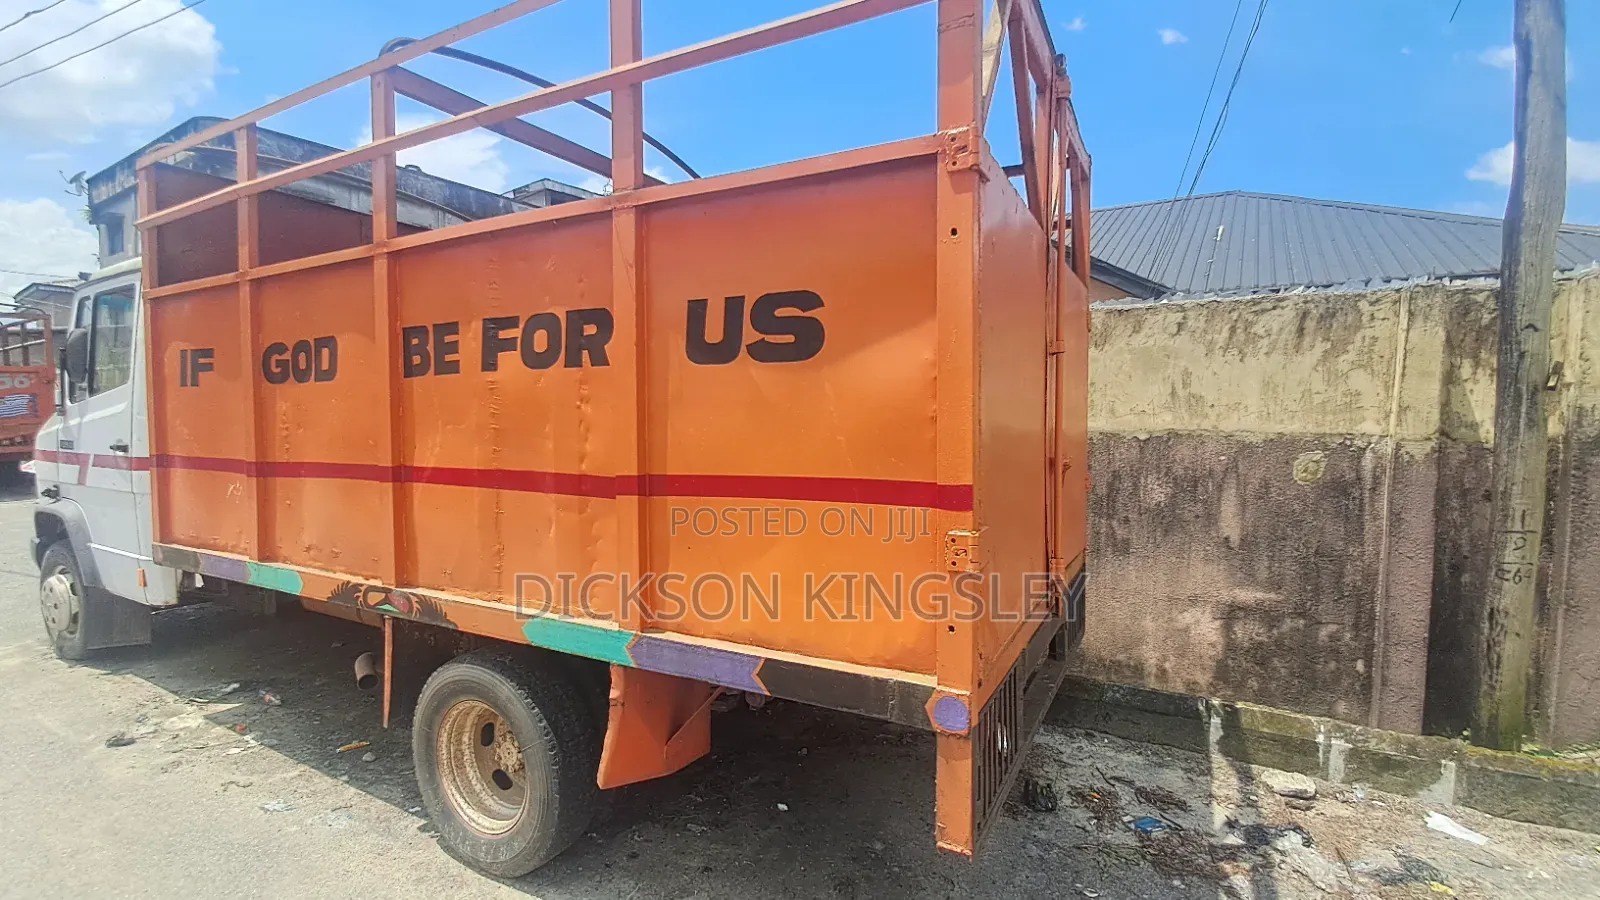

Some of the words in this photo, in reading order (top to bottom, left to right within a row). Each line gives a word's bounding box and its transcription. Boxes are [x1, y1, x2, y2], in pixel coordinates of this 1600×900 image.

[179, 348, 214, 387] IF
[262, 335, 338, 384] GOD
[402, 321, 460, 379] BE
[481, 307, 614, 372] FOR
[685, 289, 825, 366] US
